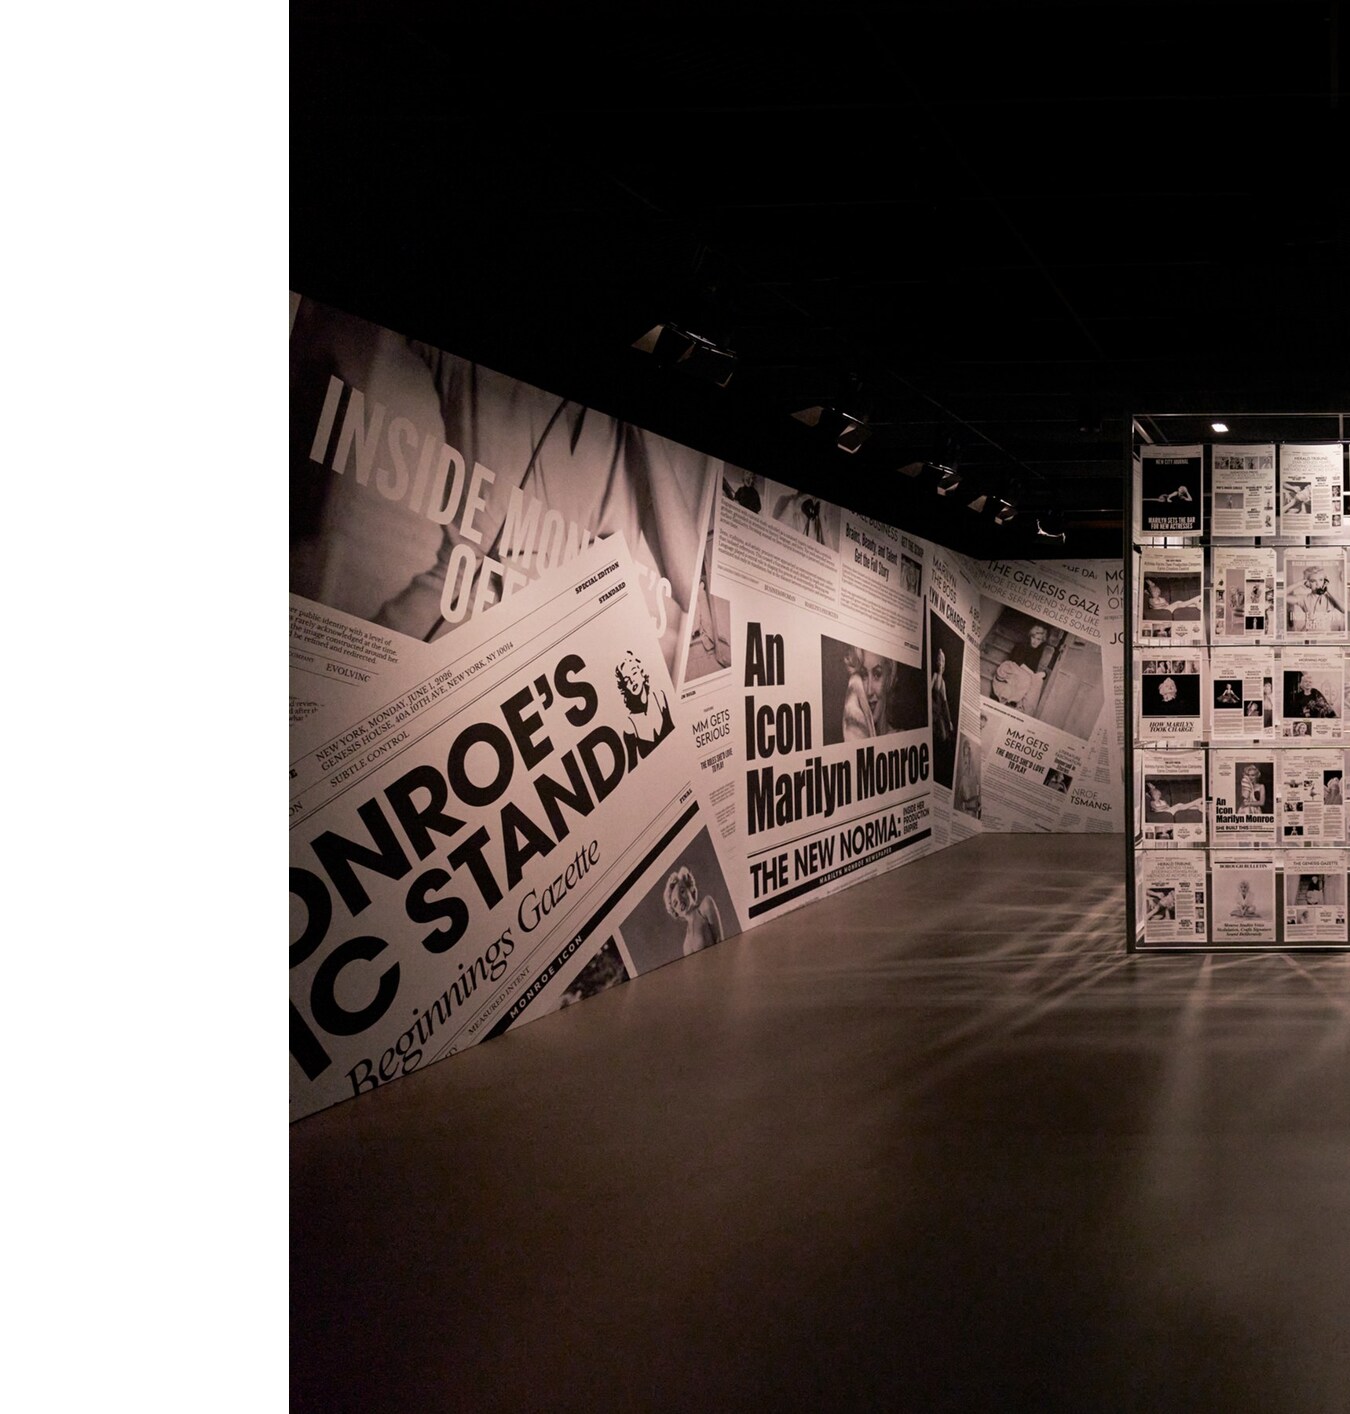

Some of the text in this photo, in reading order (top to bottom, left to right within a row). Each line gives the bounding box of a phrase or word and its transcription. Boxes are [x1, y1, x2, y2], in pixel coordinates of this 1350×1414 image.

[309, 374, 495, 545] INSIDE
[575, 562, 620, 594] SPECIAL EDITION
[598, 582, 626, 604] STANDARD
[942, 581, 957, 605] BOSS
[988, 560, 1012, 577] THE
[1014, 571, 1066, 601] GENESIS
[983, 582, 1007, 598] MORE
[1008, 593, 1042, 613] SERIOUS
[1043, 607, 1068, 624] ROLES
[1029, 590, 1058, 609] FRIEND
[1084, 613, 1099, 627] LIKE
[303, 626, 325, 640] image
[326, 634, 364, 653] constructed
[744, 621, 786, 688] An
[316, 741, 340, 762] NEW
[341, 725, 369, 745] YORK,
[368, 700, 409, 728] MONDAY,
[407, 688, 429, 704] JUNE
[434, 671, 453, 686] 2026
[321, 741, 362, 771] GENESIS
[361, 720, 396, 745] HOUSE,
[395, 708, 411, 723] 40A
[448, 673, 466, 689] NEW
[465, 660, 487, 678] YORK,
[692, 709, 730, 736] MM GETS
[745, 695, 812, 762] Icon
[695, 723, 730, 748] SERIOUS
[1004, 737, 1044, 760] SERIOUS
[1006, 728, 1049, 752] MM GETS
[330, 760, 367, 787] SUBTLE
[367, 731, 410, 763] CONTROL
[746, 750, 852, 836] Marilyn
[856, 742, 930, 806] Monroe
[1216, 798, 1226, 806] An
[903, 808, 930, 824] PRODUCTION
[1216, 806, 1233, 814] Icon
[1216, 815, 1274, 824] Marilyn Monroe
[405, 725, 627, 954] STAND
[750, 814, 901, 899] THE NEW NORMA:
[819, 847, 893, 884] MARILYN MONROE NEWSPAPER
[345, 838, 601, 1097] Beginnings Gazette
[509, 934, 583, 1019] MONROE ICON
[468, 966, 530, 1037] MEASURED INTENT
